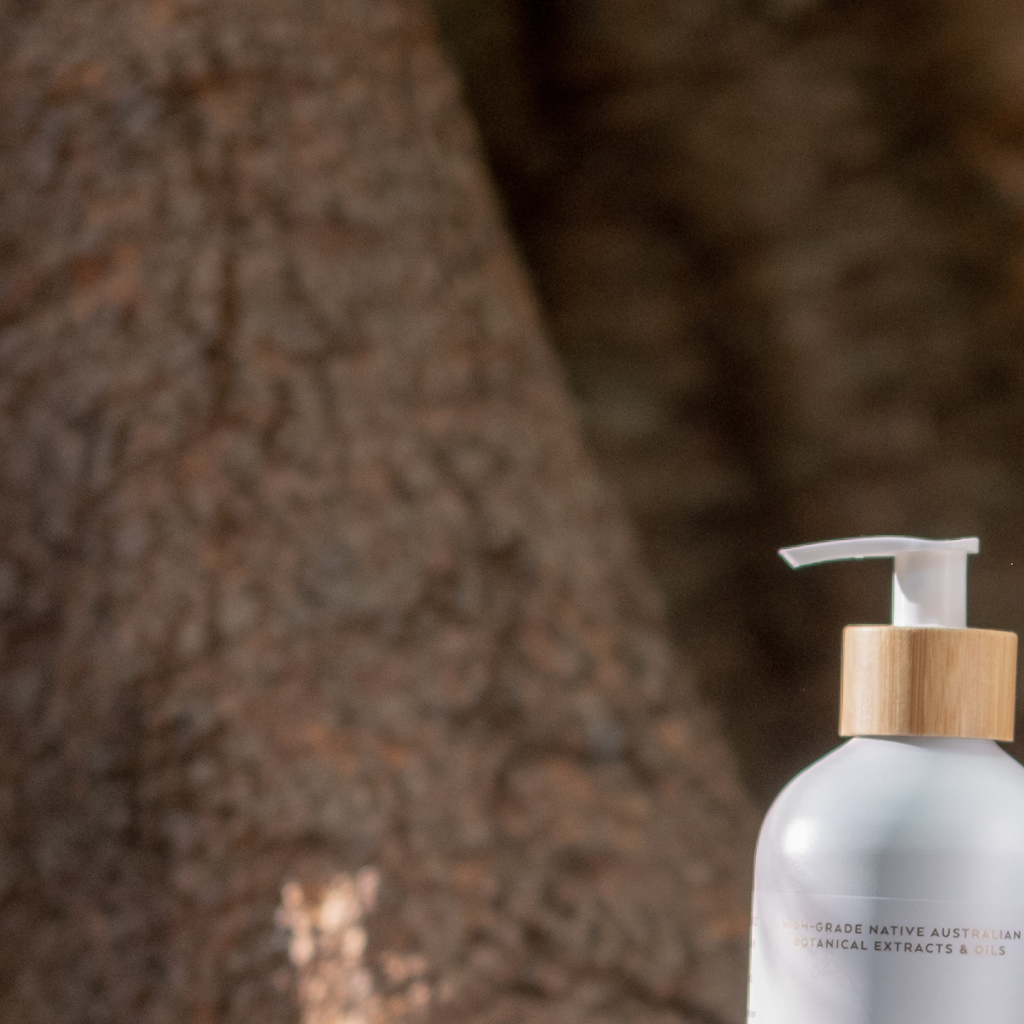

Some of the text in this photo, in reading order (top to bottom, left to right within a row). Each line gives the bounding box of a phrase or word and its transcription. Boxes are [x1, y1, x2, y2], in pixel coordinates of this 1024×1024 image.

[782, 920, 1022, 940] HIGH-GRADE NATIVE AUSTRALIAN
[793, 937, 1006, 956] BOTANICAL EXTRACTS & OILS
